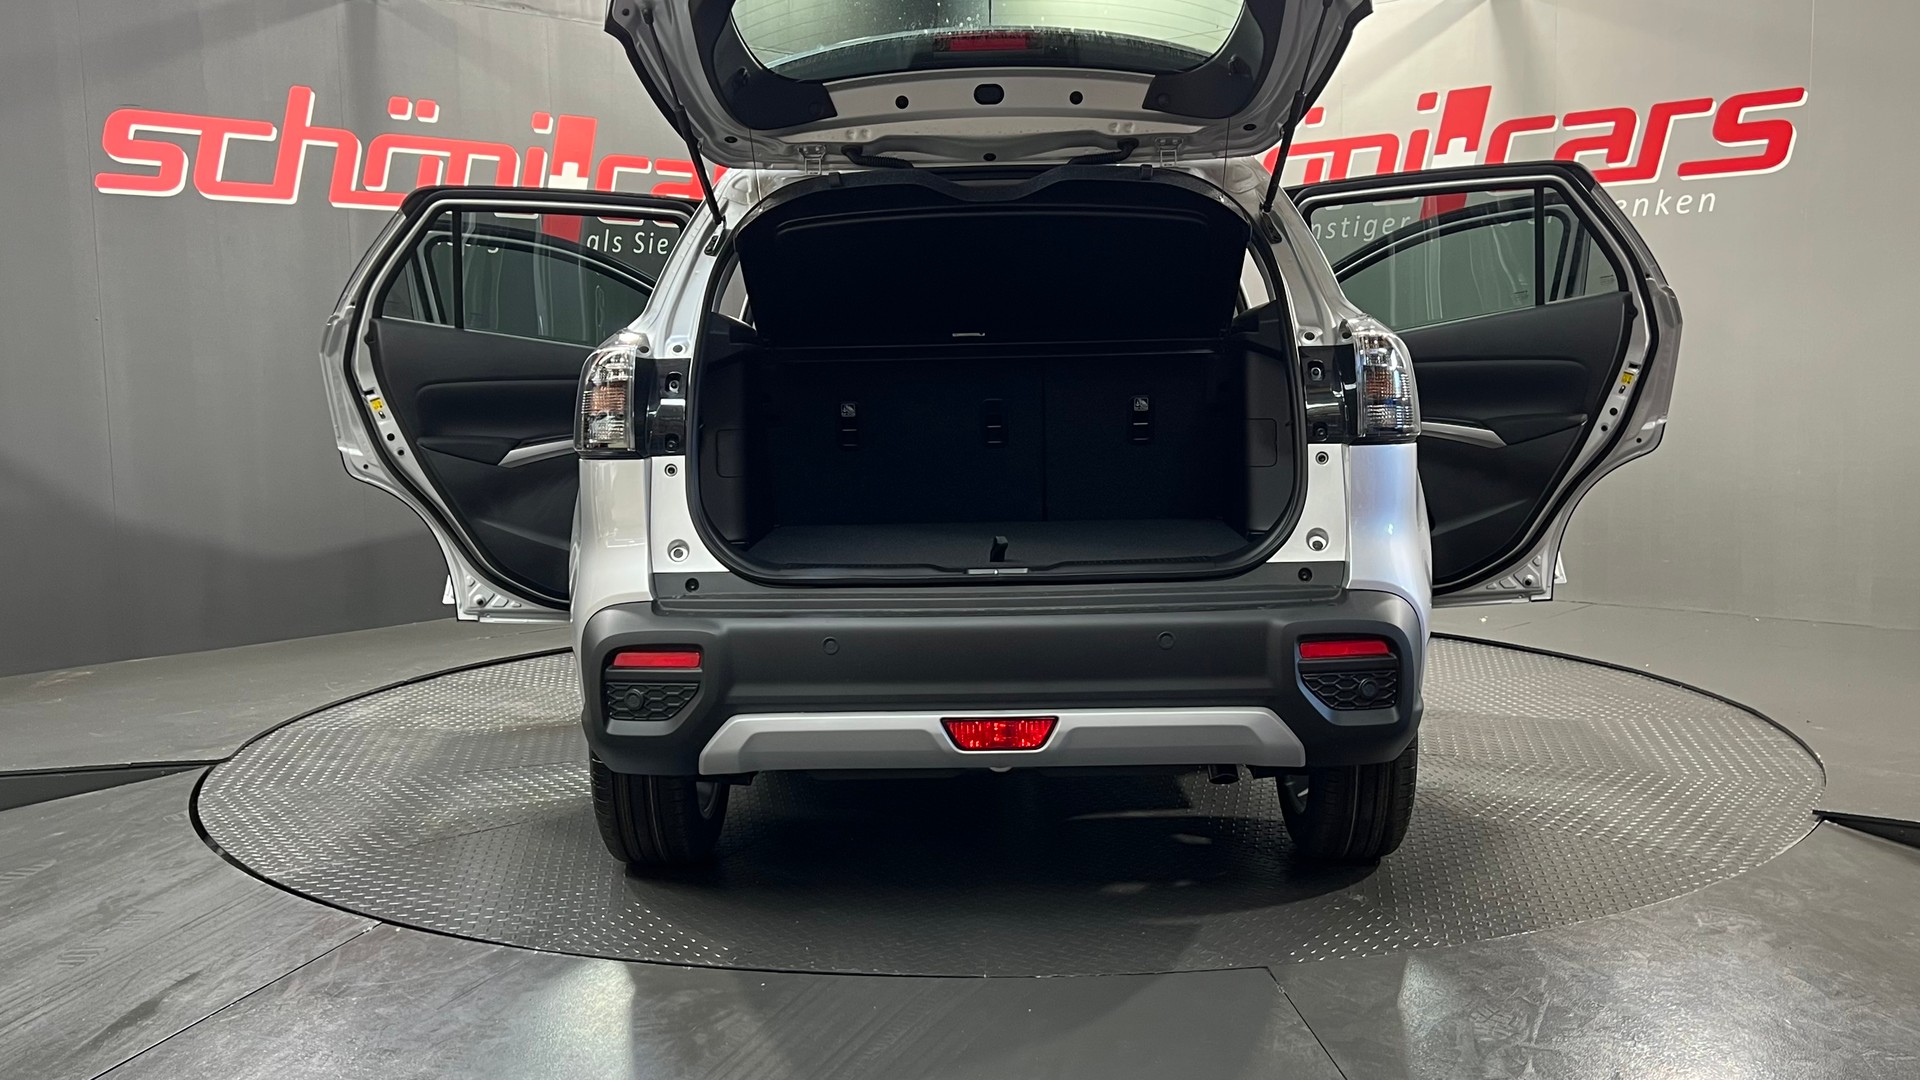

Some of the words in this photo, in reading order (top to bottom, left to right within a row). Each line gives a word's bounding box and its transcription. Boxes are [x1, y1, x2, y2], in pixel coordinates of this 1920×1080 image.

[1311, 215, 1411, 242] nstiger
[1615, 188, 1716, 217] enken
[586, 228, 622, 253] als
[633, 231, 669, 255] Sie
